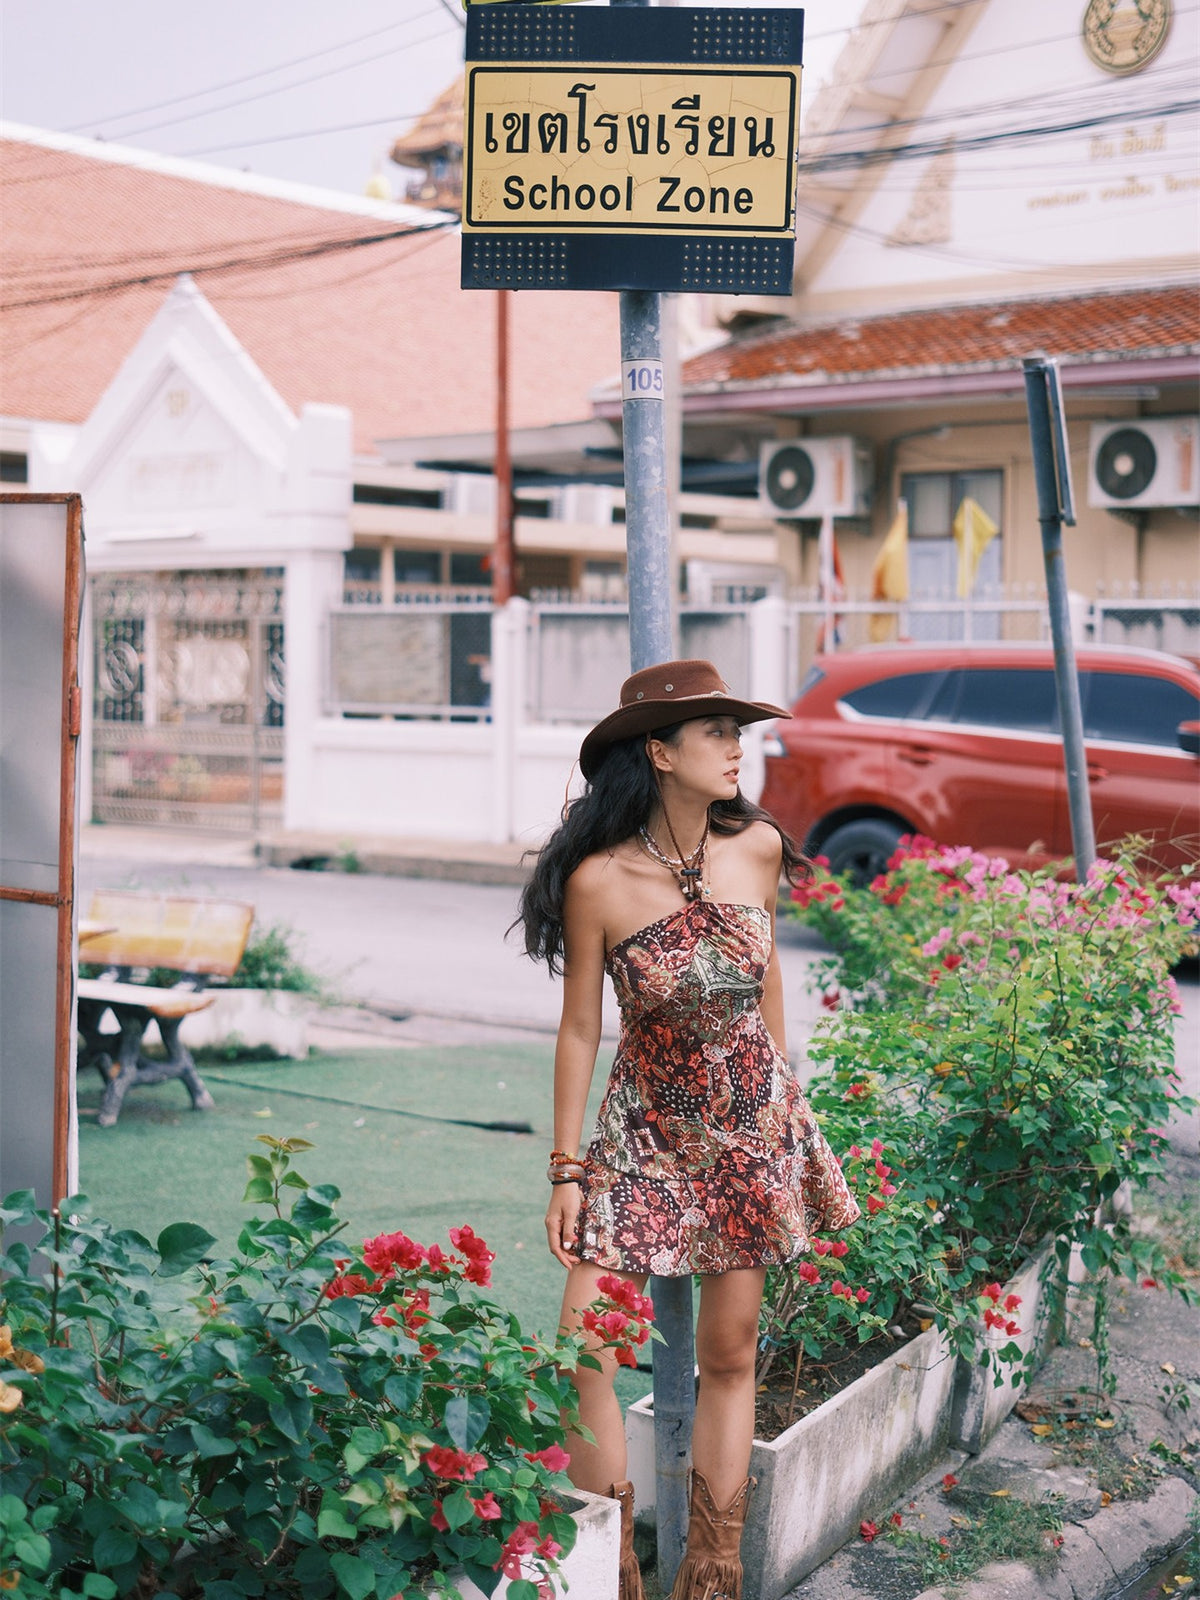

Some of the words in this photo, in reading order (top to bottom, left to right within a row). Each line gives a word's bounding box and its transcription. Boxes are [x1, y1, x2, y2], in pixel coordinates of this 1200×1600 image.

[485, 84, 775, 157] เขตโรงเรียน
[503, 175, 633, 211] School
[657, 177, 754, 214] Zone
[627, 367, 663, 392] 105
